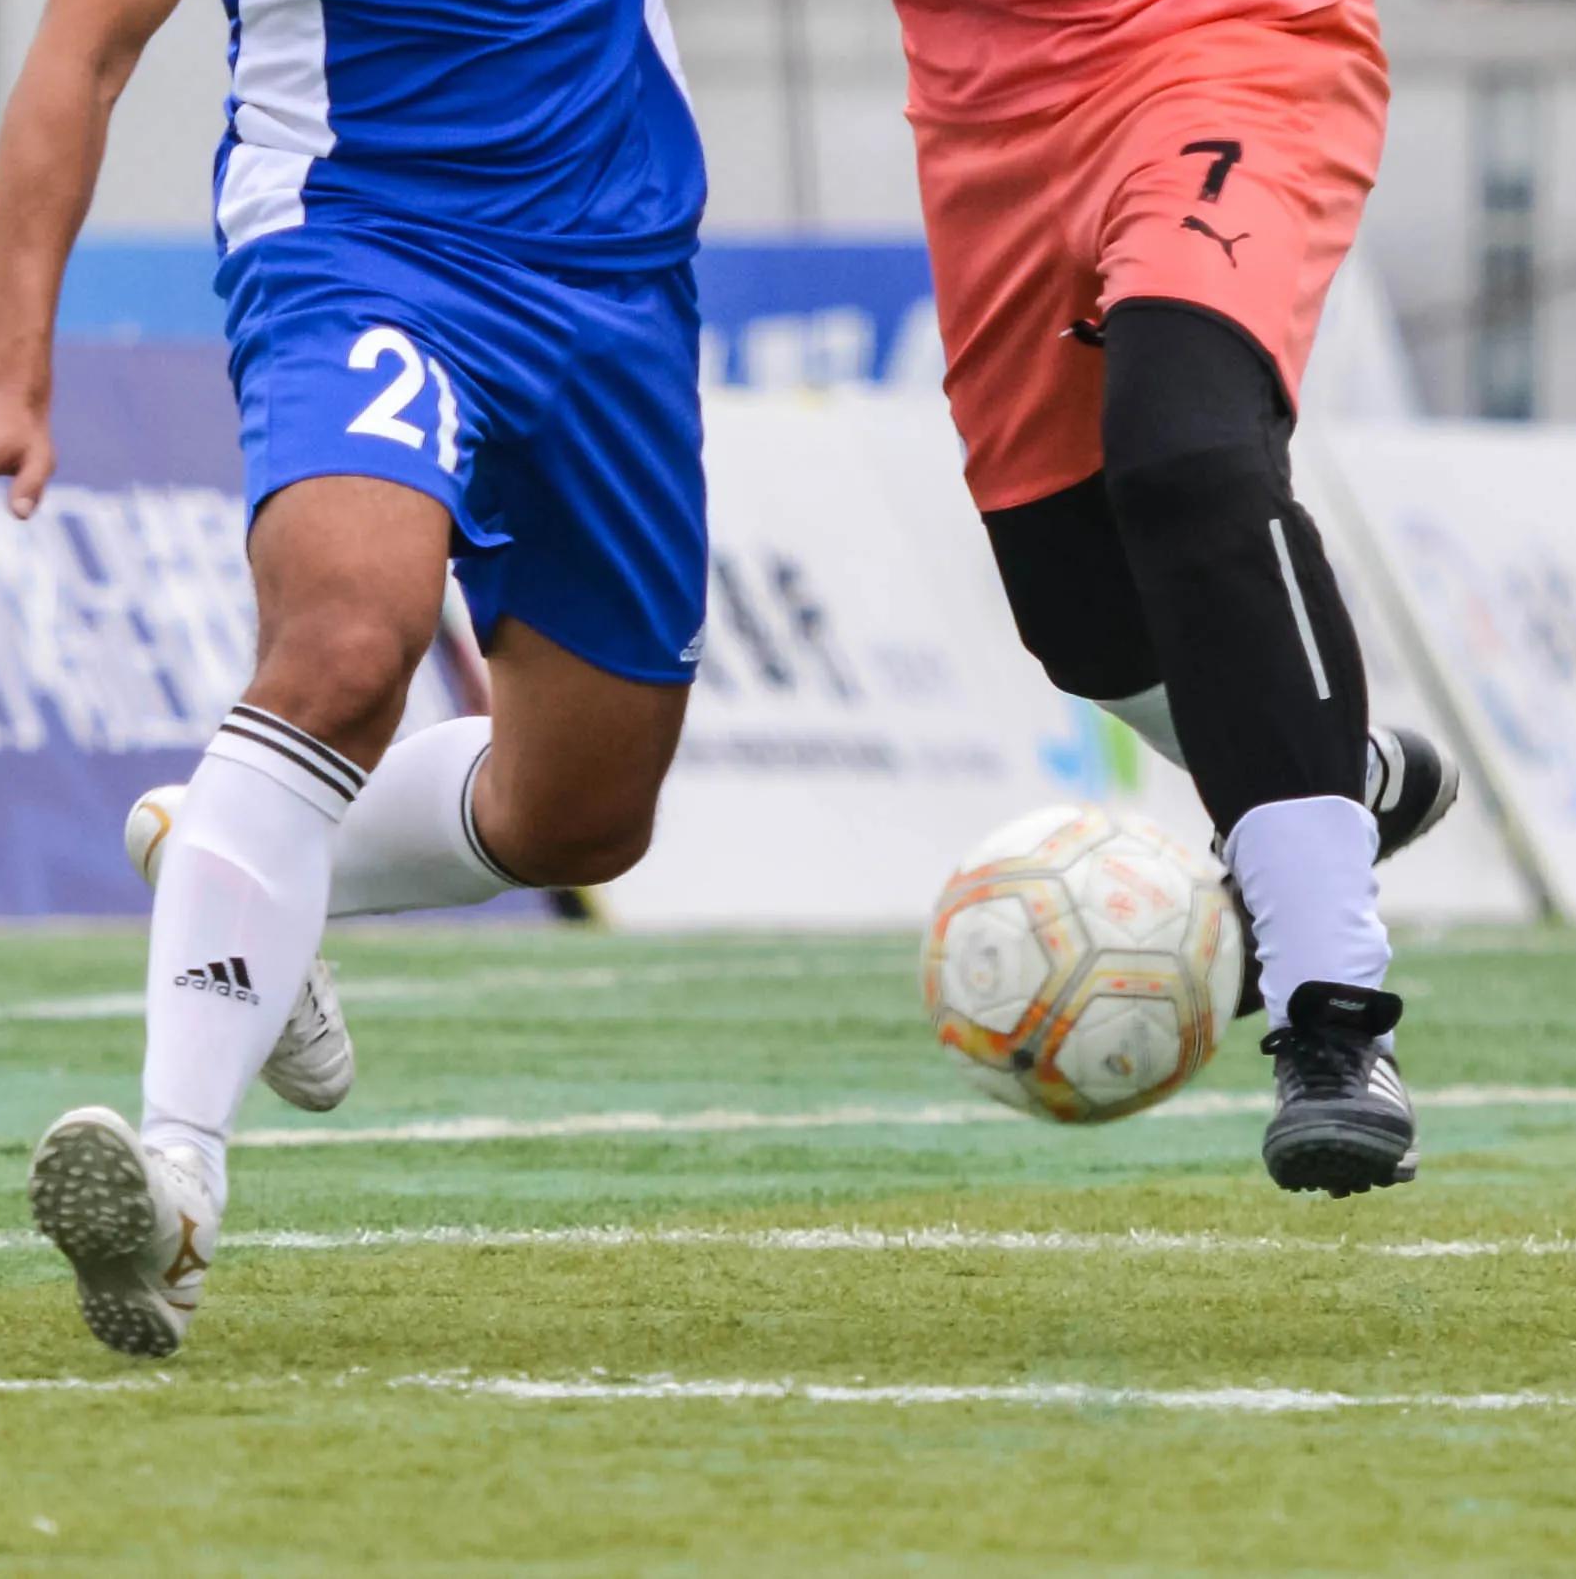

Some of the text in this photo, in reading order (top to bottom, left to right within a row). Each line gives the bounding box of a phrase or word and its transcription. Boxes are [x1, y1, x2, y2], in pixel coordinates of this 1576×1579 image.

[1179, 139, 1243, 204] 7
[345, 325, 459, 474] 21
[173, 974, 261, 1007] adidas
